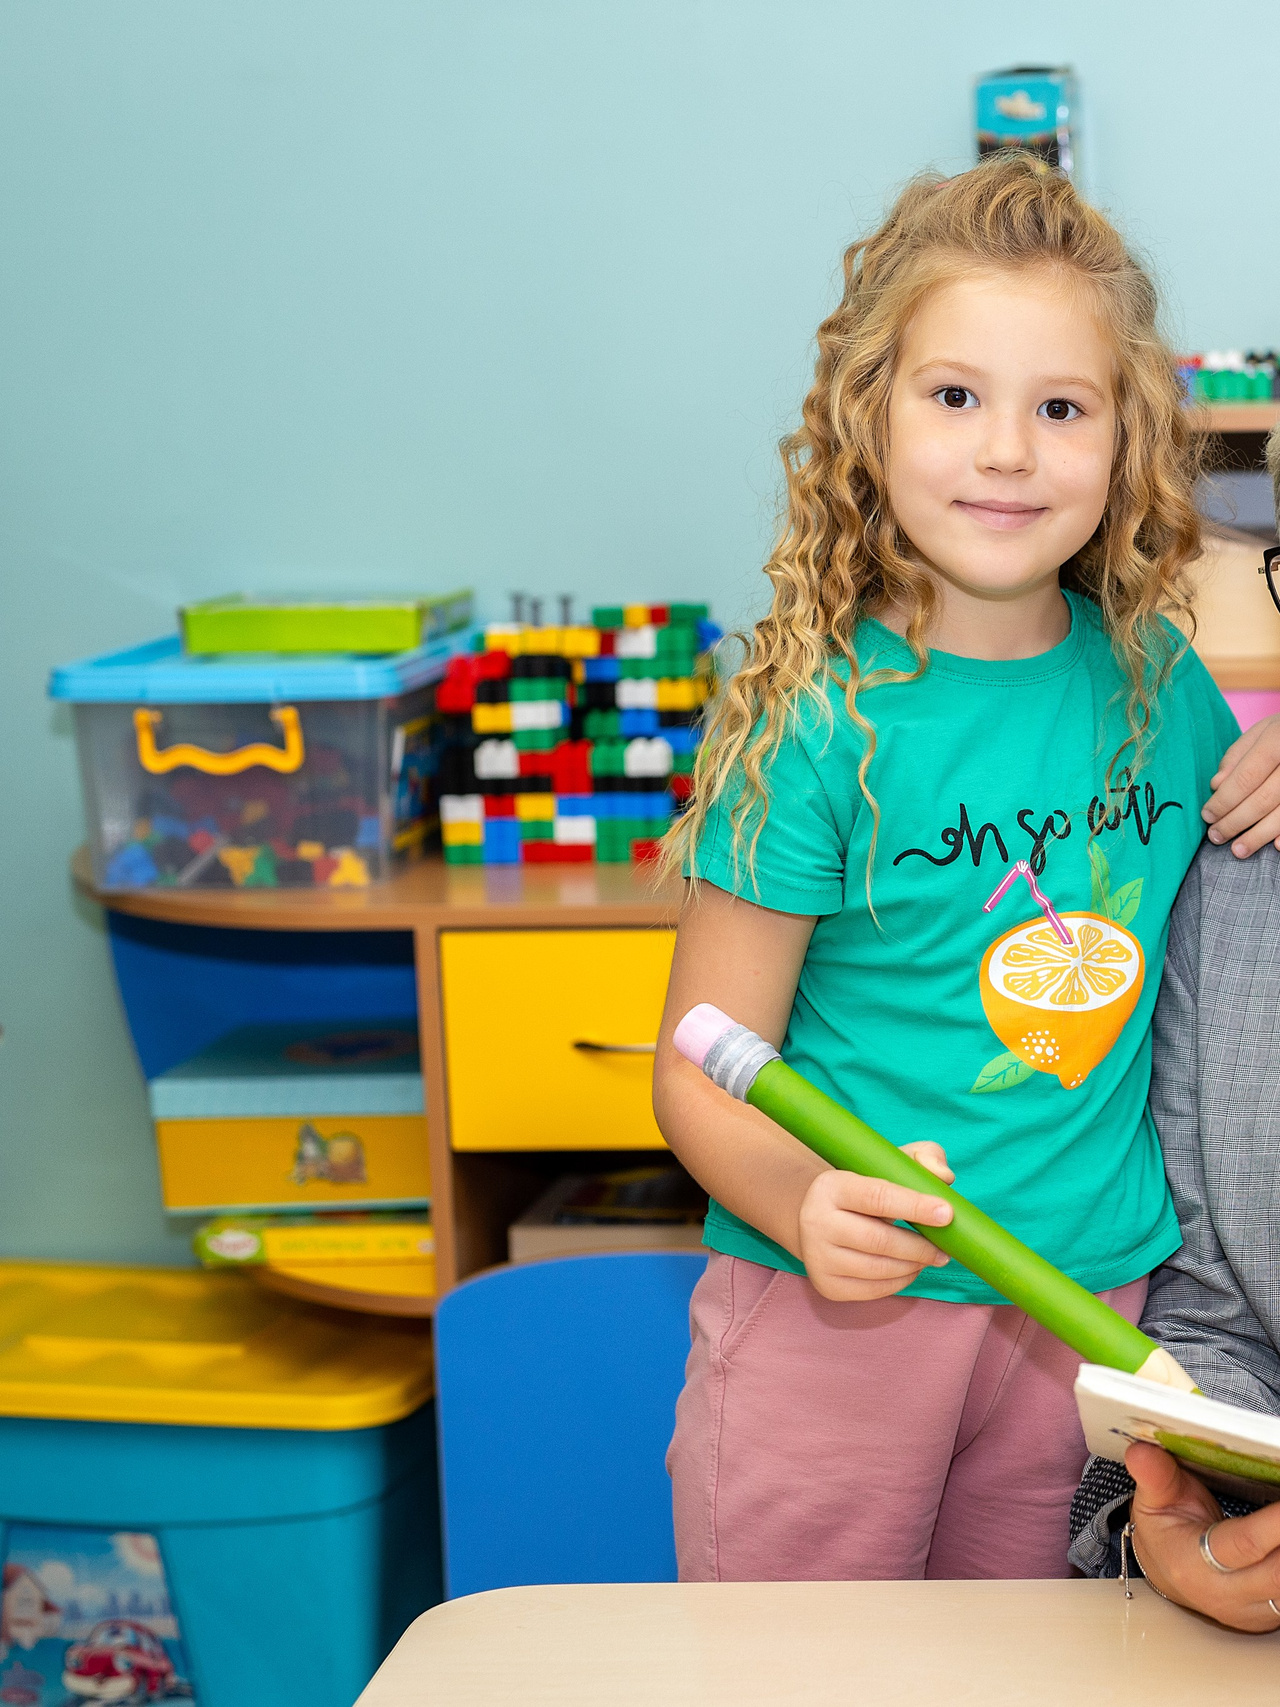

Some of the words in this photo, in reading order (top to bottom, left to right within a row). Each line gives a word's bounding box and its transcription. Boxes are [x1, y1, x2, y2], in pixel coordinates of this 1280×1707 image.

[893, 803, 1009, 867] oh
[1016, 809, 1072, 876] so
[1087, 766, 1183, 846] cute
